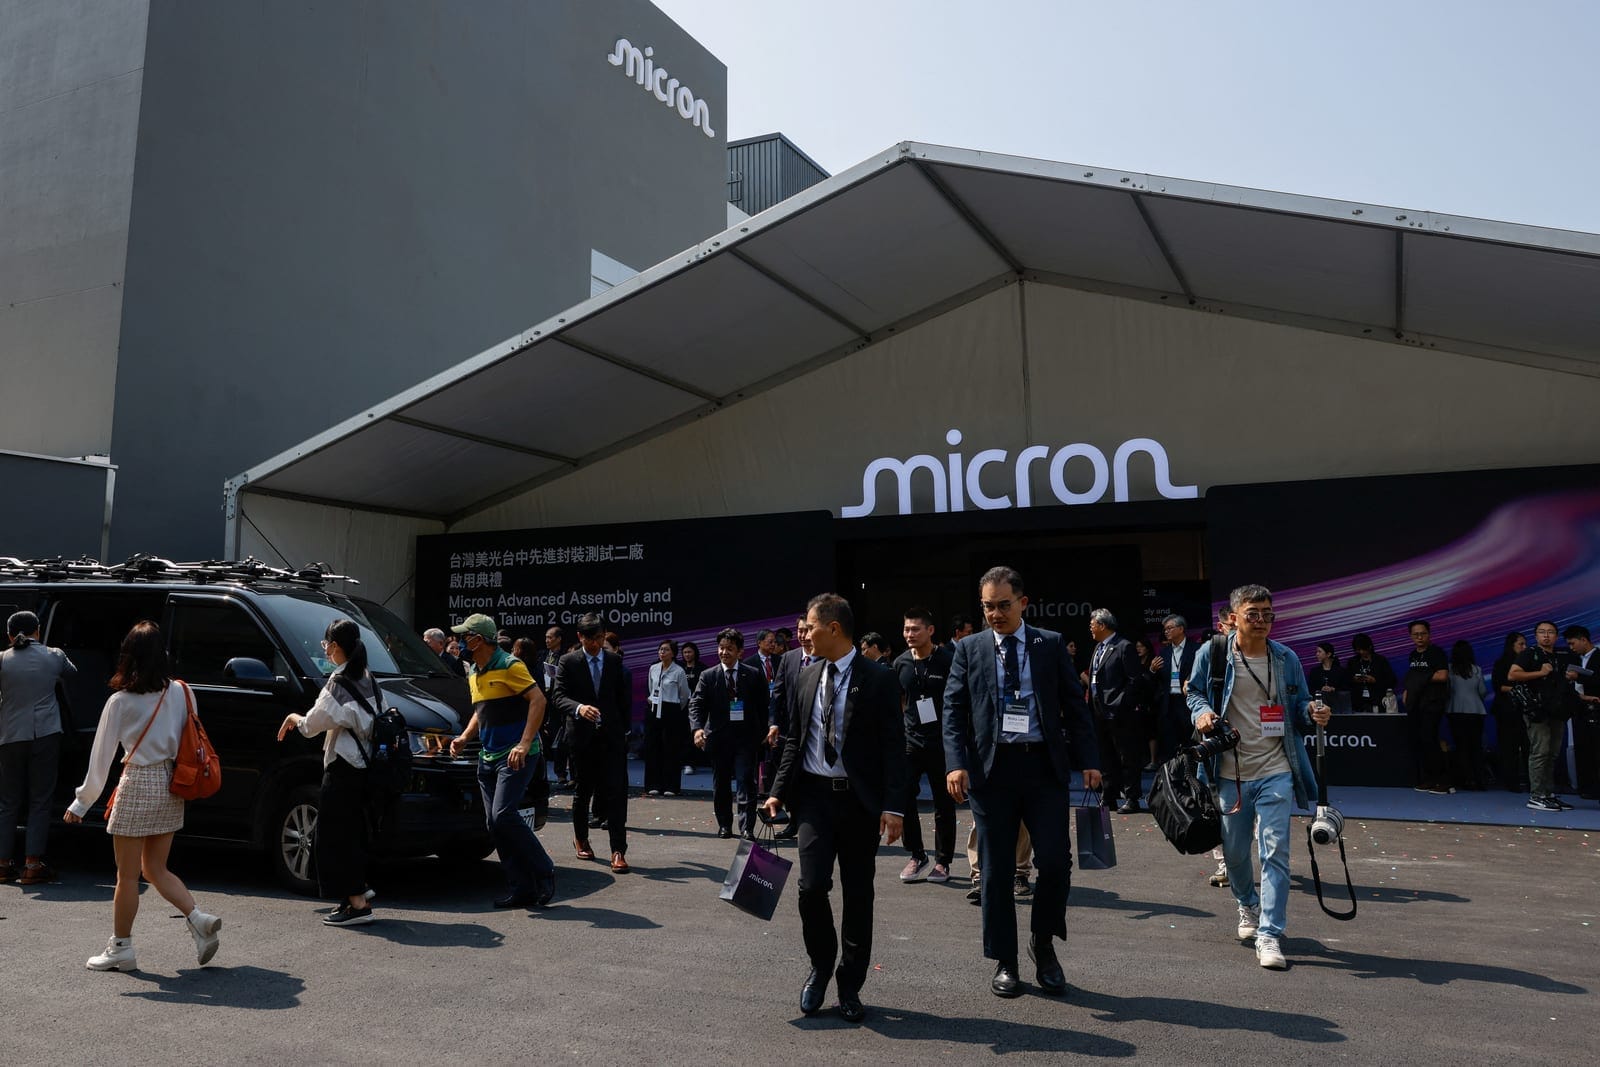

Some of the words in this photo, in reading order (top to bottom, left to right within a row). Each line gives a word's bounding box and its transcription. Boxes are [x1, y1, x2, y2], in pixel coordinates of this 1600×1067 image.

[607, 38, 715, 138] micron
[841, 428, 1198, 519] micron
[449, 543, 644, 569] 台灣美光台中先進封裝測試二廠
[448, 594, 493, 609] Micron
[497, 592, 565, 608] Advanced
[569, 588, 639, 606] Assembly
[643, 587, 672, 603] and
[499, 611, 544, 626] Taiwan
[547, 610, 557, 625] 2
[608, 607, 673, 626] Opening
[748, 872, 774, 890] micron
